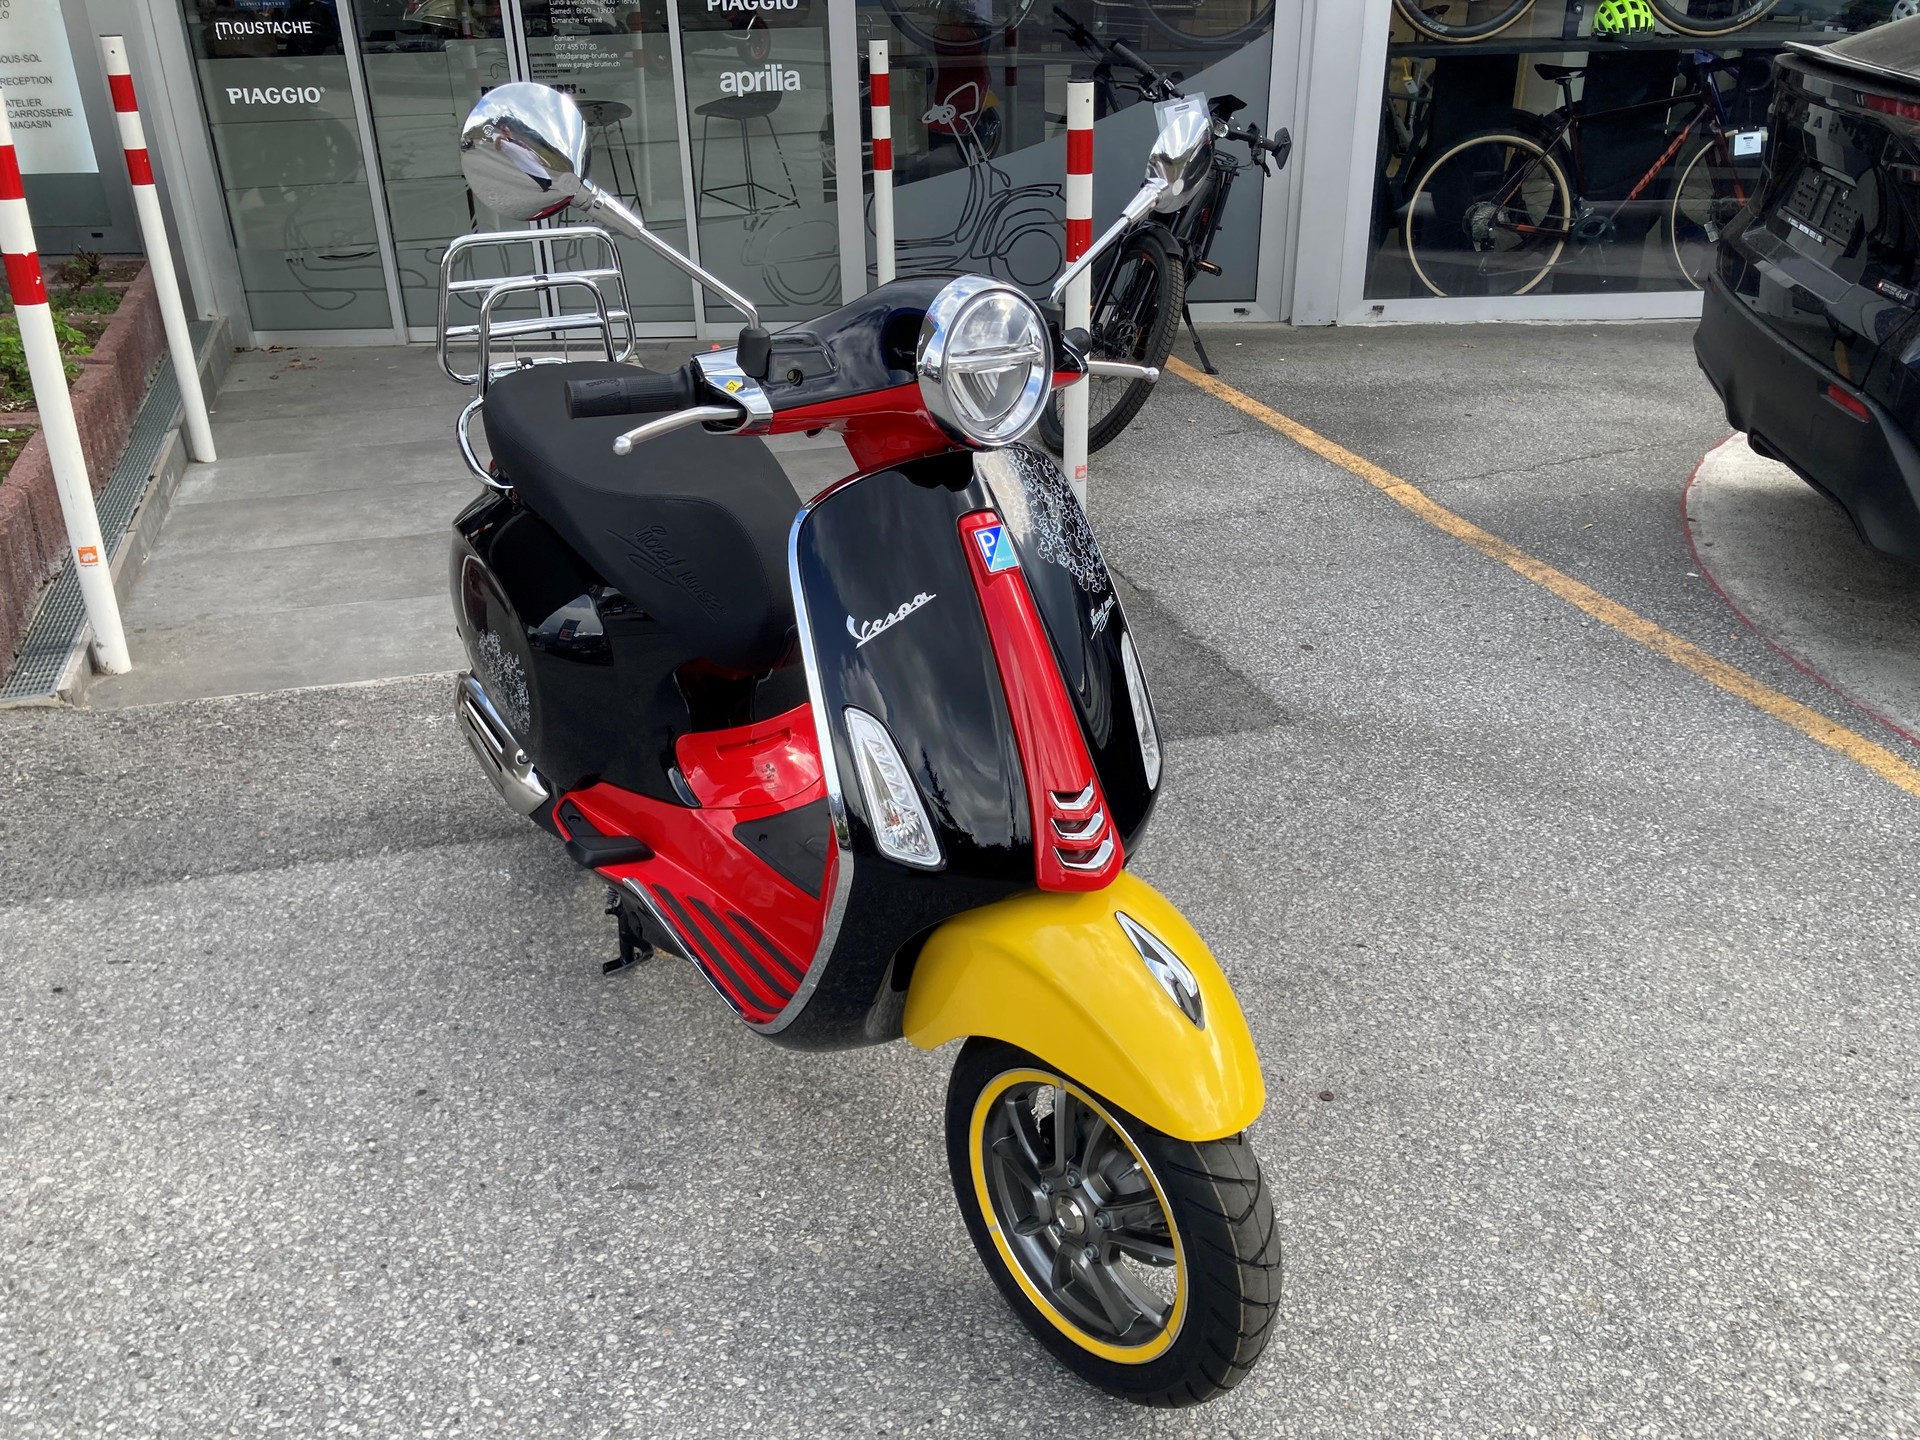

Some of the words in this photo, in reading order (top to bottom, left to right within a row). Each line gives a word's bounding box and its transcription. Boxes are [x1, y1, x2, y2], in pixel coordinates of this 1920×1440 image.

[550, 7, 571, 15] Samedi
[553, 34, 575, 42] Contact
[0, 54, 42, 64] OUS-SOL
[0, 76, 53, 86] RECEPTION
[719, 64, 801, 97] aprilia
[6, 98, 42, 108] ATELIER
[8, 108, 74, 119] CARROSSERIE
[10, 120, 52, 130] MAGASIN
[978, 532, 996, 557] P
[846, 592, 937, 649] Vespa
